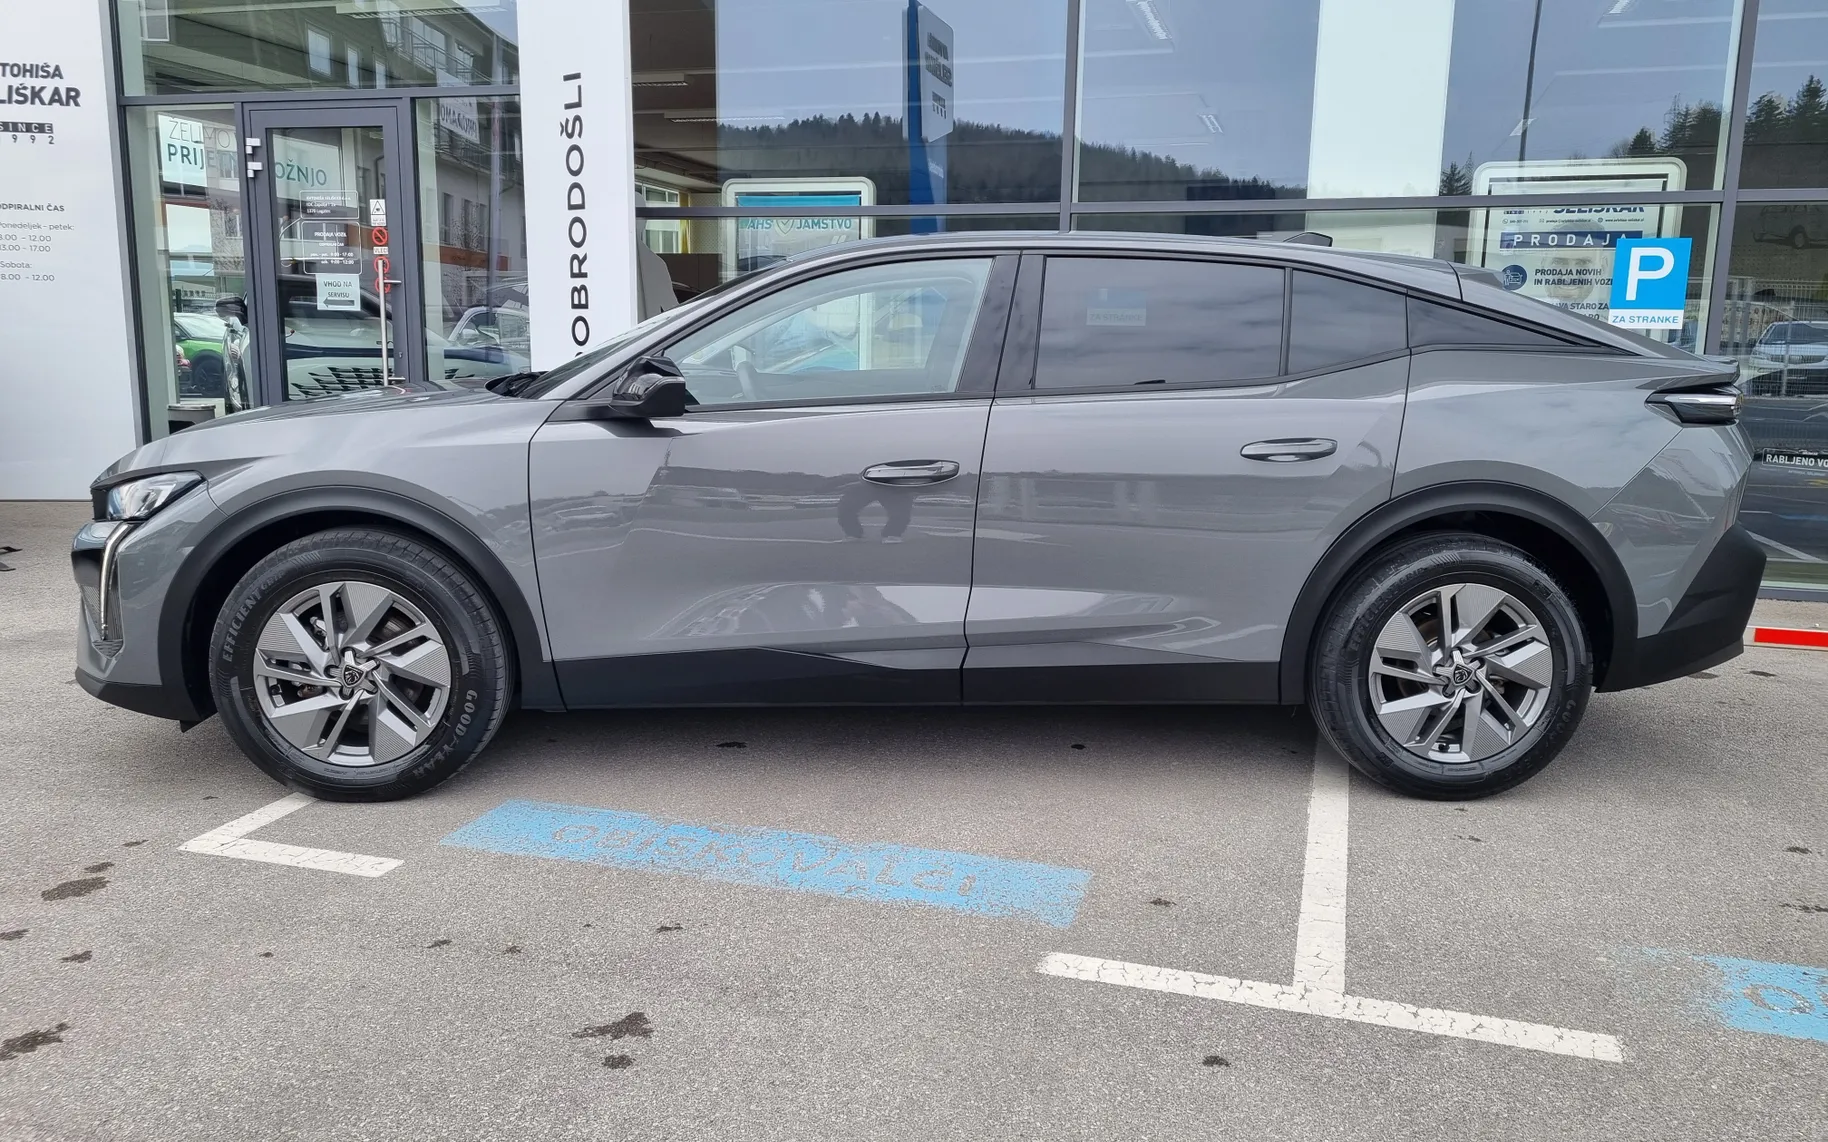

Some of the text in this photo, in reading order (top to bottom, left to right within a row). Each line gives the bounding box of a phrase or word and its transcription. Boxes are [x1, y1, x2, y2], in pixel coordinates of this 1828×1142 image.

[0, 62, 64, 79] TOHIŠA
[46, 202, 65, 212] ČAS
[559, 72, 590, 356] OBRODOŠLI
[747, 218, 852, 230] AHS JAMSTVO
[28, 234, 52, 242] 12.00
[1534, 268, 1602, 276] PRODAJA NOVIH
[1625, 247, 1675, 301] P
[0, 273, 21, 281] 8.00
[32, 274, 55, 282] 12.00
[1533, 278, 1544, 286] IN
[1544, 278, 1592, 286] RABLJENIH
[323, 280, 341, 288] VHOD
[1570, 302, 1597, 310] STARO
[1597, 302, 1610, 310] ZA
[1612, 315, 1680, 324] ZA STRANKE
[1766, 453, 1815, 467] RABLJENO
[222, 588, 263, 663] EFFICIENT
